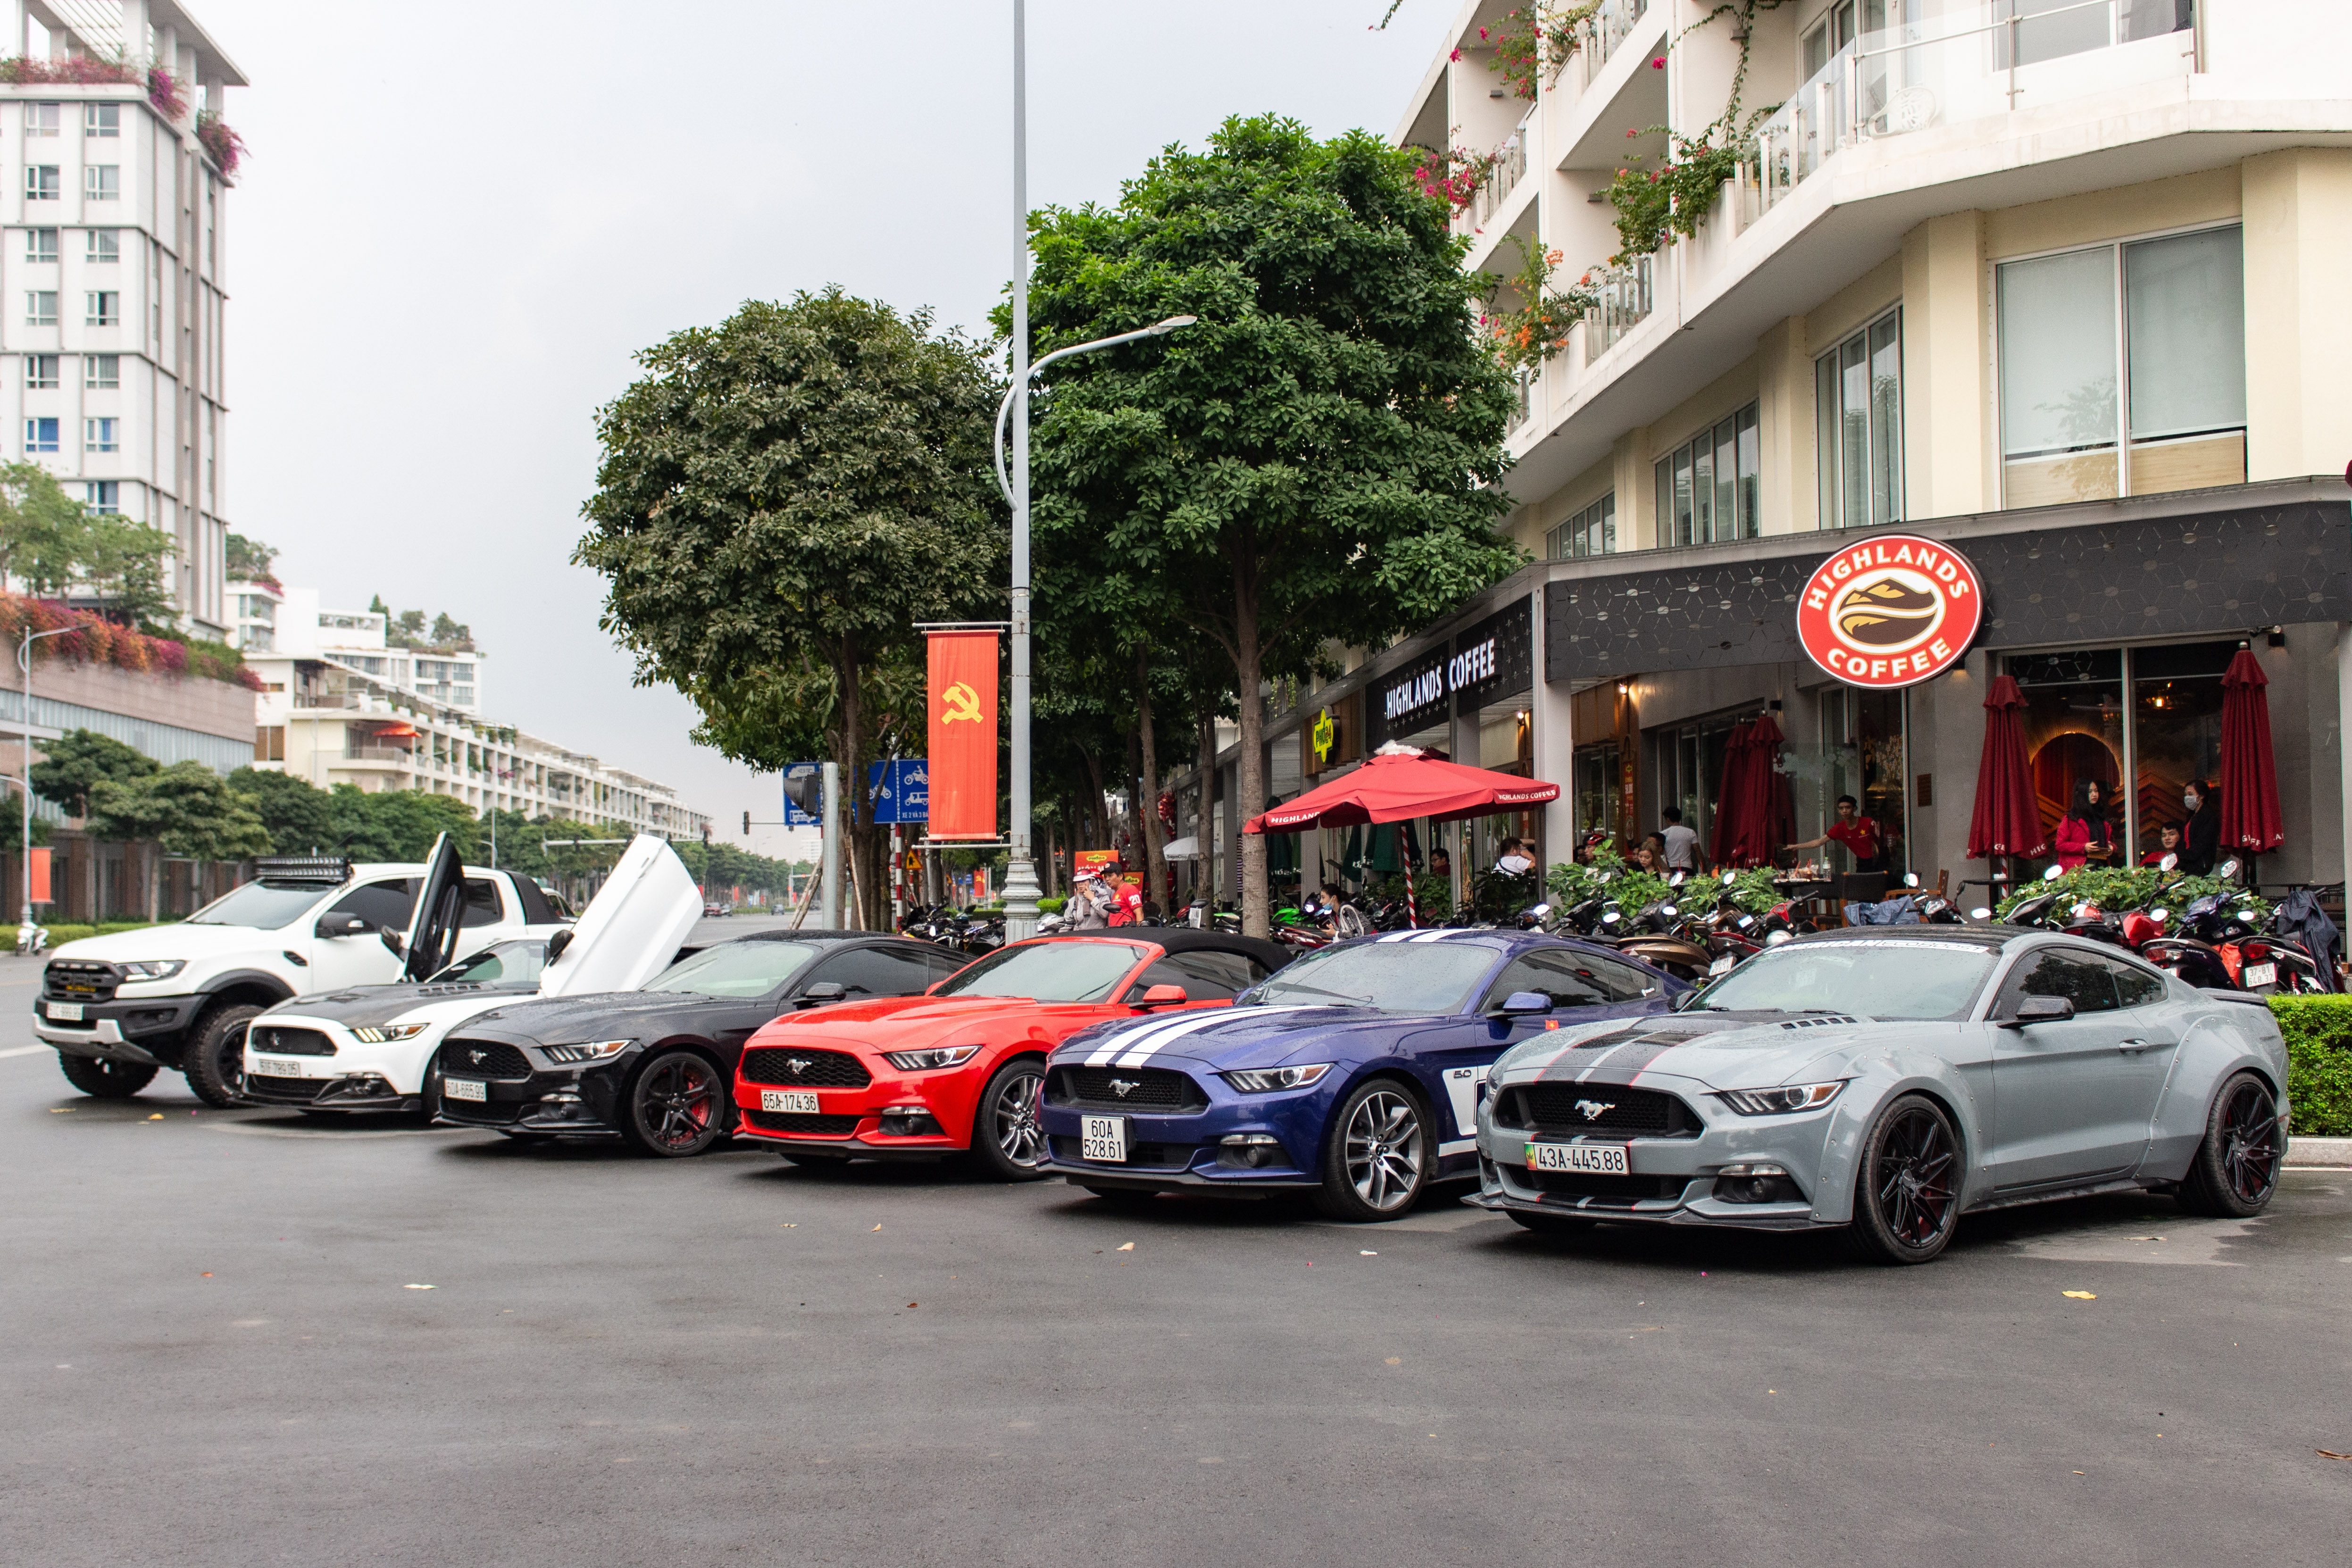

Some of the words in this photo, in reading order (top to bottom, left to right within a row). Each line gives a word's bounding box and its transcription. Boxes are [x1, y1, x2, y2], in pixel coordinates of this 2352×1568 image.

[1807, 544, 1969, 611] HIGHLANDS
[1827, 637, 1952, 679] COFFEE
[1387, 665, 1442, 720] HIGHLANDS
[1449, 638, 1494, 692] COFFEE
[1530, 790, 1556, 799] COFFEE
[1129, 894, 1141, 906] 20
[1763, 940, 1881, 955] AMERICAN
[1882, 941, 1984, 952] ECOBOOST
[2248, 974, 2273, 985] 648.32
[2249, 966, 2270, 976] 37-B1
[764, 1093, 816, 1110] 65A-174.36
[1092, 1120, 1113, 1138] 60A
[1084, 1139, 1121, 1159] 528.61
[1539, 1147, 1624, 1171] 43A-445.88
